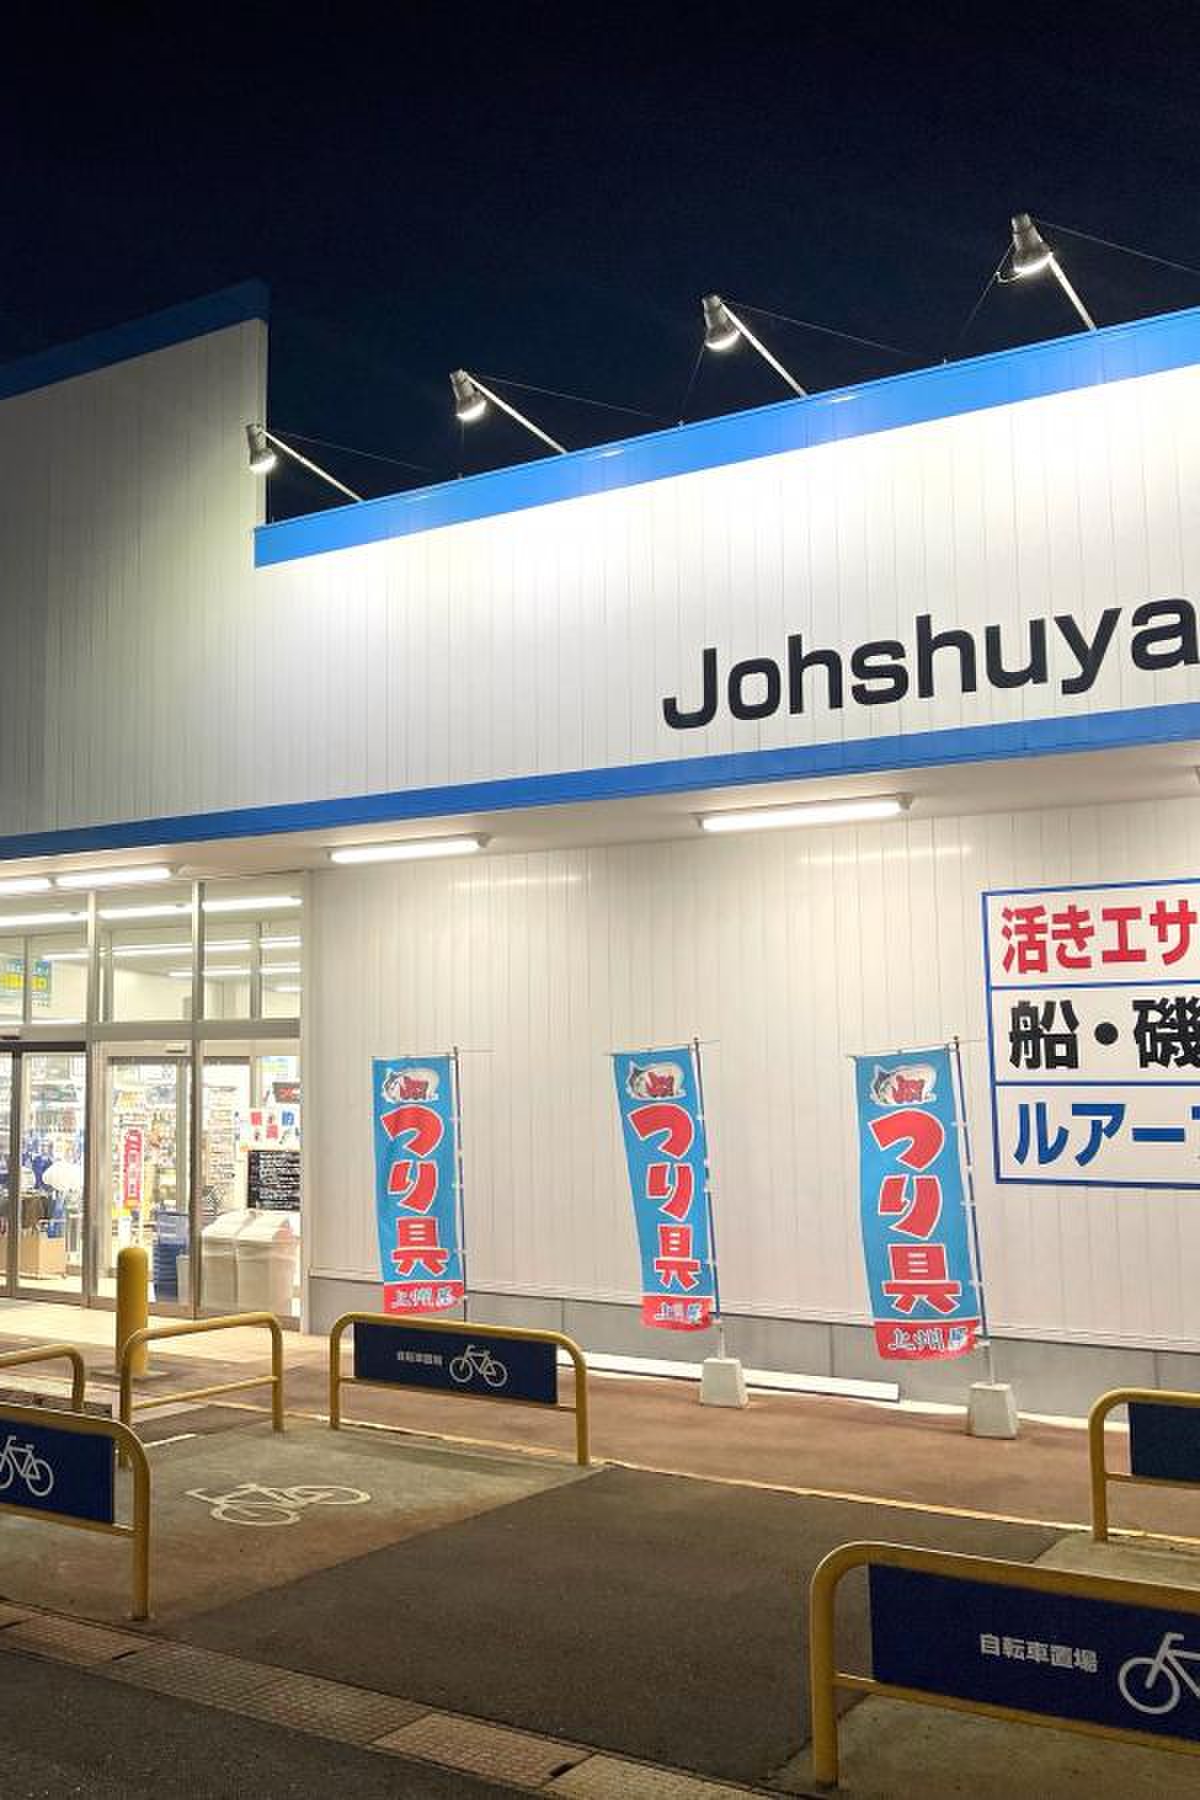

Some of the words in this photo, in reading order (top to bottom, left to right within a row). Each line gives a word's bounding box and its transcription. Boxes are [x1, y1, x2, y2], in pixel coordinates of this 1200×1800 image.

[662, 597, 1200, 730] Johshuya
[1001, 900, 1198, 974] 活きエサ
[1008, 996, 1200, 1070] 船・磯
[1013, 1102, 1200, 1167] ルアー
[380, 1104, 449, 1276] つり具
[628, 1103, 701, 1292] つり具
[867, 1108, 962, 1315] つり具
[979, 1633, 1099, 1674] 自転車置場
